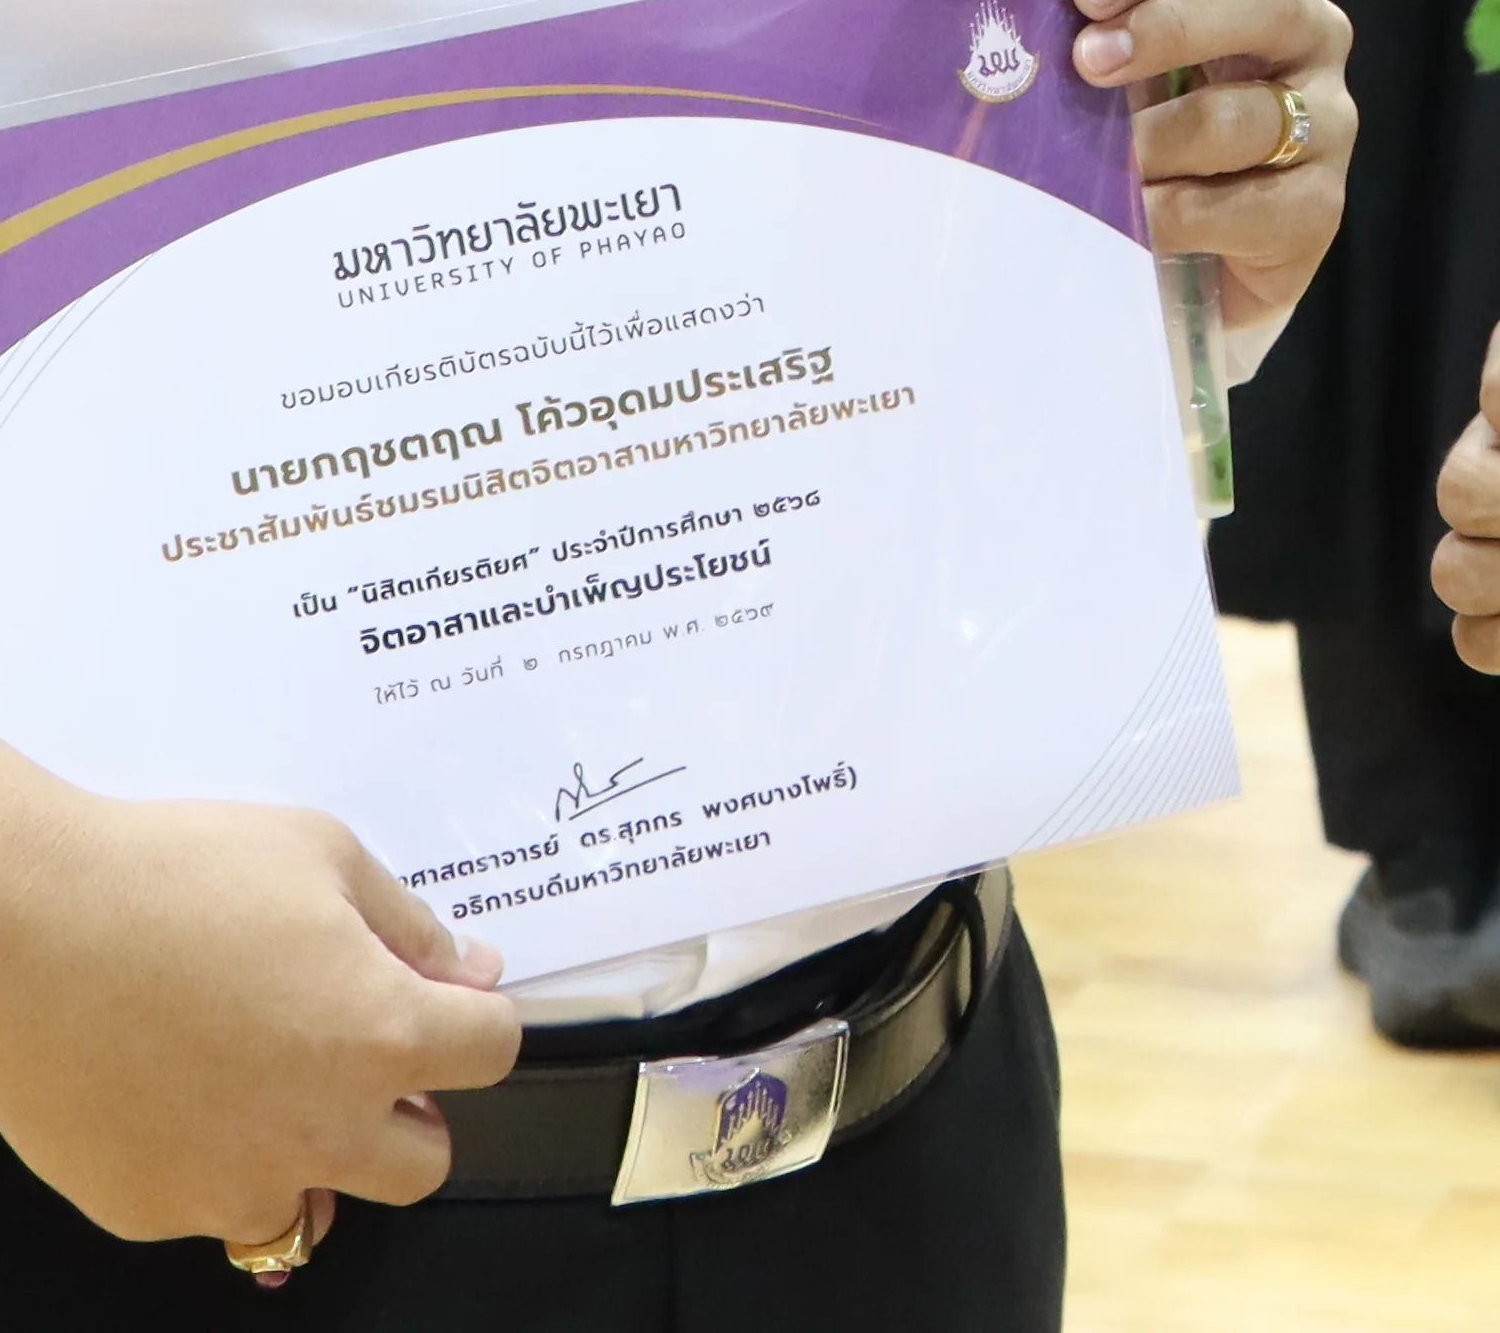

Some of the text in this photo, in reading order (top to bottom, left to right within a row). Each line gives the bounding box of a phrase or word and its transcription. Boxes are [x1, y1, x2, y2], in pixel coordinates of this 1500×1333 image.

[332, 182, 683, 282] มหาวิทยาลัยพะเยา
[337, 221, 686, 309] UNIVERSITY OF PHAYAO
[279, 292, 765, 410] ขอมอบเกียรติบัตรฉบับนี้ไว้เพื่อแสดงว่า
[230, 345, 835, 496] นายกฤชตฤณ โค้วอุดมประเสริฐ
[160, 385, 916, 563] ประชาสัมพันธ์ชมรมนิสิตจิตอาสามหาวิทยาลัยพะเยา
[291, 591, 339, 619] เป็น
[551, 507, 744, 563] ประจำปีการศึกษา
[359, 537, 773, 656] จิตอาสาและบำเพ็ญประโยชน์
[373, 678, 420, 705] ให้ไว้
[429, 675, 452, 693] ณ
[460, 654, 504, 686] วันที่
[522, 657, 539, 672] ๒
[558, 630, 653, 664] กรกฎาคม
[662, 618, 705, 640] พ.ศ.
[579, 811, 684, 845] ดร.สุภกร
[700, 760, 858, 820] พงศบางโพธิ์)
[451, 830, 772, 920] อธิการบดีมหาวิทยาลัยพะเยา
